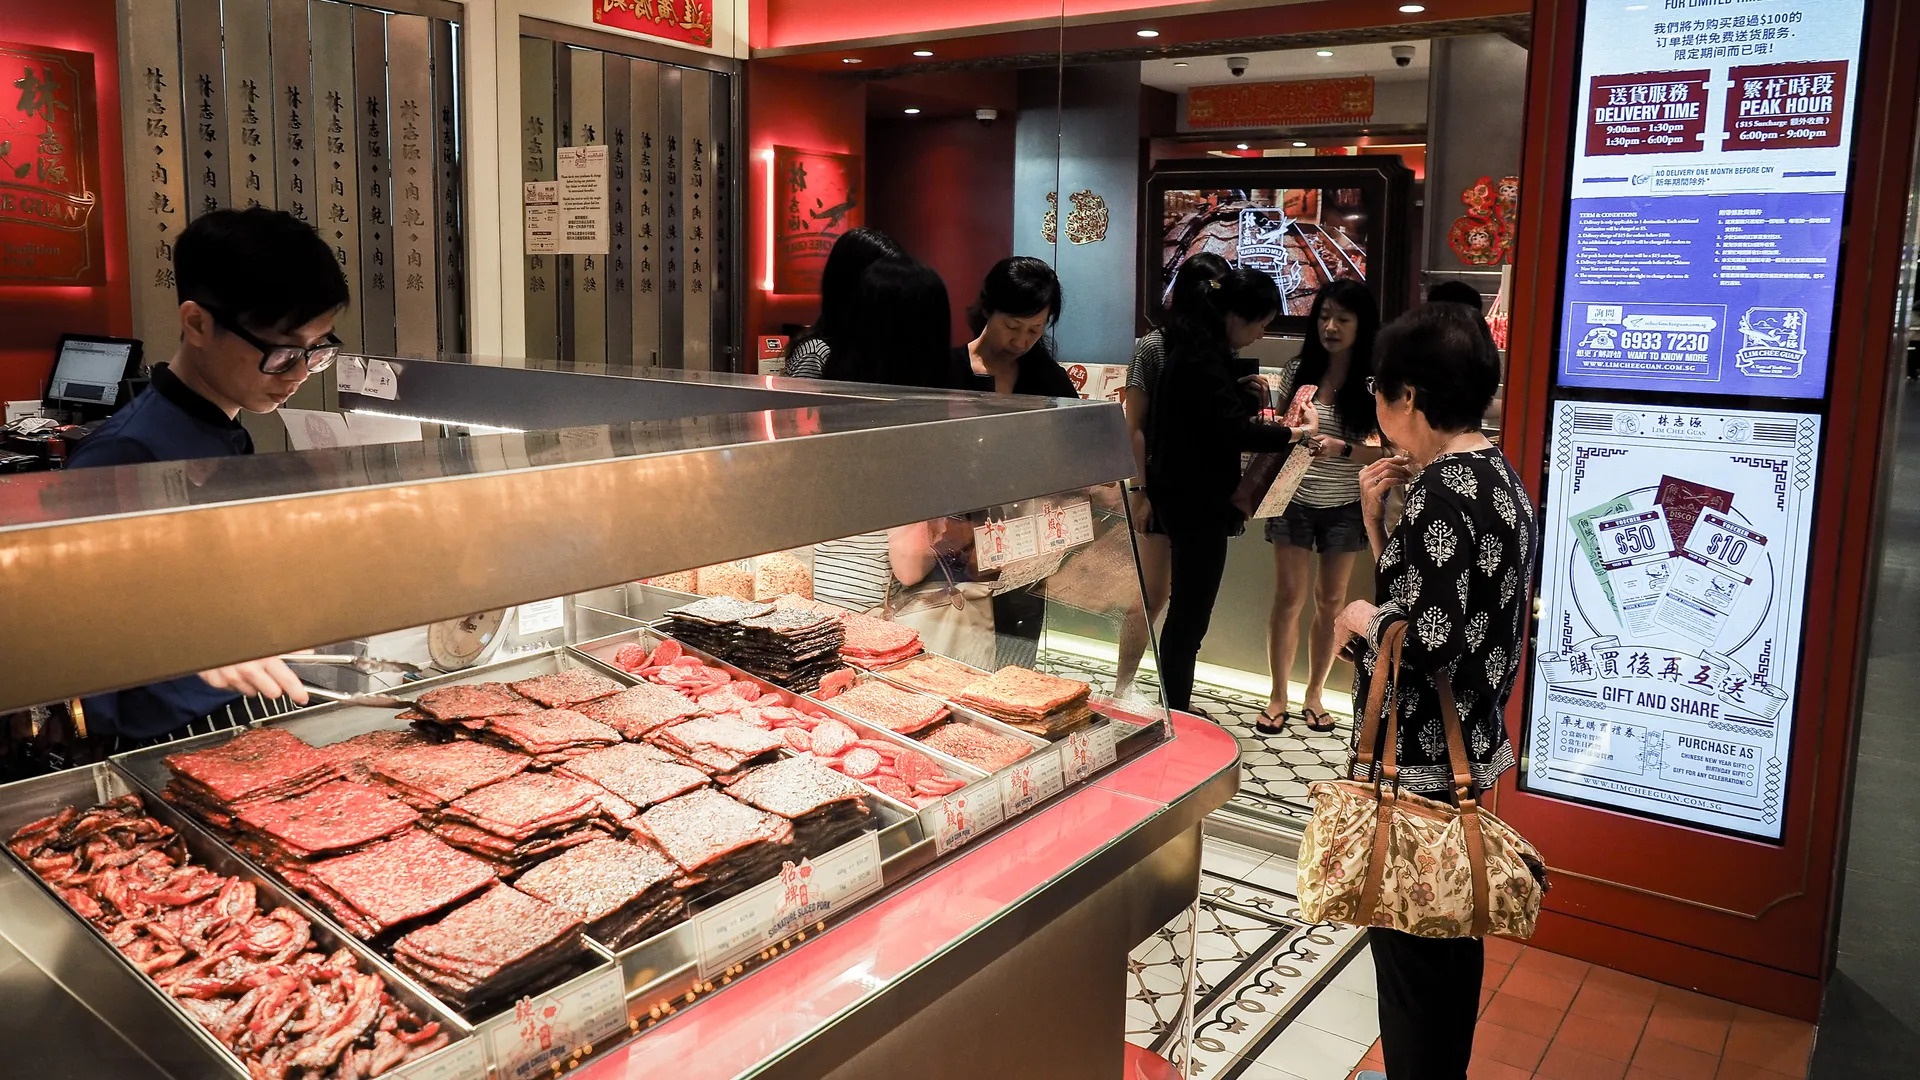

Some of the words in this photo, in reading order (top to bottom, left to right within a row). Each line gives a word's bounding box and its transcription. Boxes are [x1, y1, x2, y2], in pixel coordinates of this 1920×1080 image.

[1608, 83, 1689, 106] 送貨服務
[1742, 75, 1835, 99] 繁忙時段
[1595, 104, 1659, 122] DELIVERY
[1664, 102, 1699, 119] TIME
[1739, 97, 1781, 115] PEAK
[1786, 95, 1832, 113] HOUR
[1606, 124, 1640, 134] 9:00am
[1648, 123, 1684, 133] 1:30pm
[1739, 130, 1778, 141] 6:00pm
[1786, 128, 1826, 139] 9:00pm
[1605, 136, 1640, 147] 1:30pm
[1647, 134, 1684, 145] 6:00pm
[1666, 168, 1694, 176] DELIVERY
[1710, 167, 1733, 175] MONTH
[1734, 166, 1759, 174] BEFORE
[1761, 166, 1774, 174] CNY
[20, 196, 78, 221] GUAN
[1620, 331, 1663, 349] 6933
[1667, 332, 1709, 351] 7230
[1627, 350, 1649, 360] WANT
[1650, 352, 1659, 360] TO
[1660, 352, 1683, 361] KNOW
[1685, 353, 1708, 362] MORE
[1780, 351, 1801, 360] GUAN
[1583, 361, 1696, 372] WWW.LIMCHEEGUAN.COM.SG
[1657, 414, 1702, 428] 林志源
[1615, 524, 1656, 555] $50
[1706, 533, 1748, 566] $10
[1569, 650, 1748, 704] 購買後再互送
[1602, 686, 1634, 705] GIFT
[1636, 691, 1666, 710] AND
[1670, 697, 1720, 719] SHARE
[1678, 736, 1737, 756] PURCHASE
[1739, 747, 1754, 759] AS
[1681, 752, 1704, 762] CHINESE
[1718, 759, 1732, 767] YEAR
[1706, 765, 1731, 774] BIRTHDAY
[1583, 777, 1723, 811] WWW.LIMCHEEGUAN.COM.SG
[768, 912, 797, 938] SIGNATURE
[797, 903, 816, 917] SLICED
[816, 901, 831, 910] PORK
